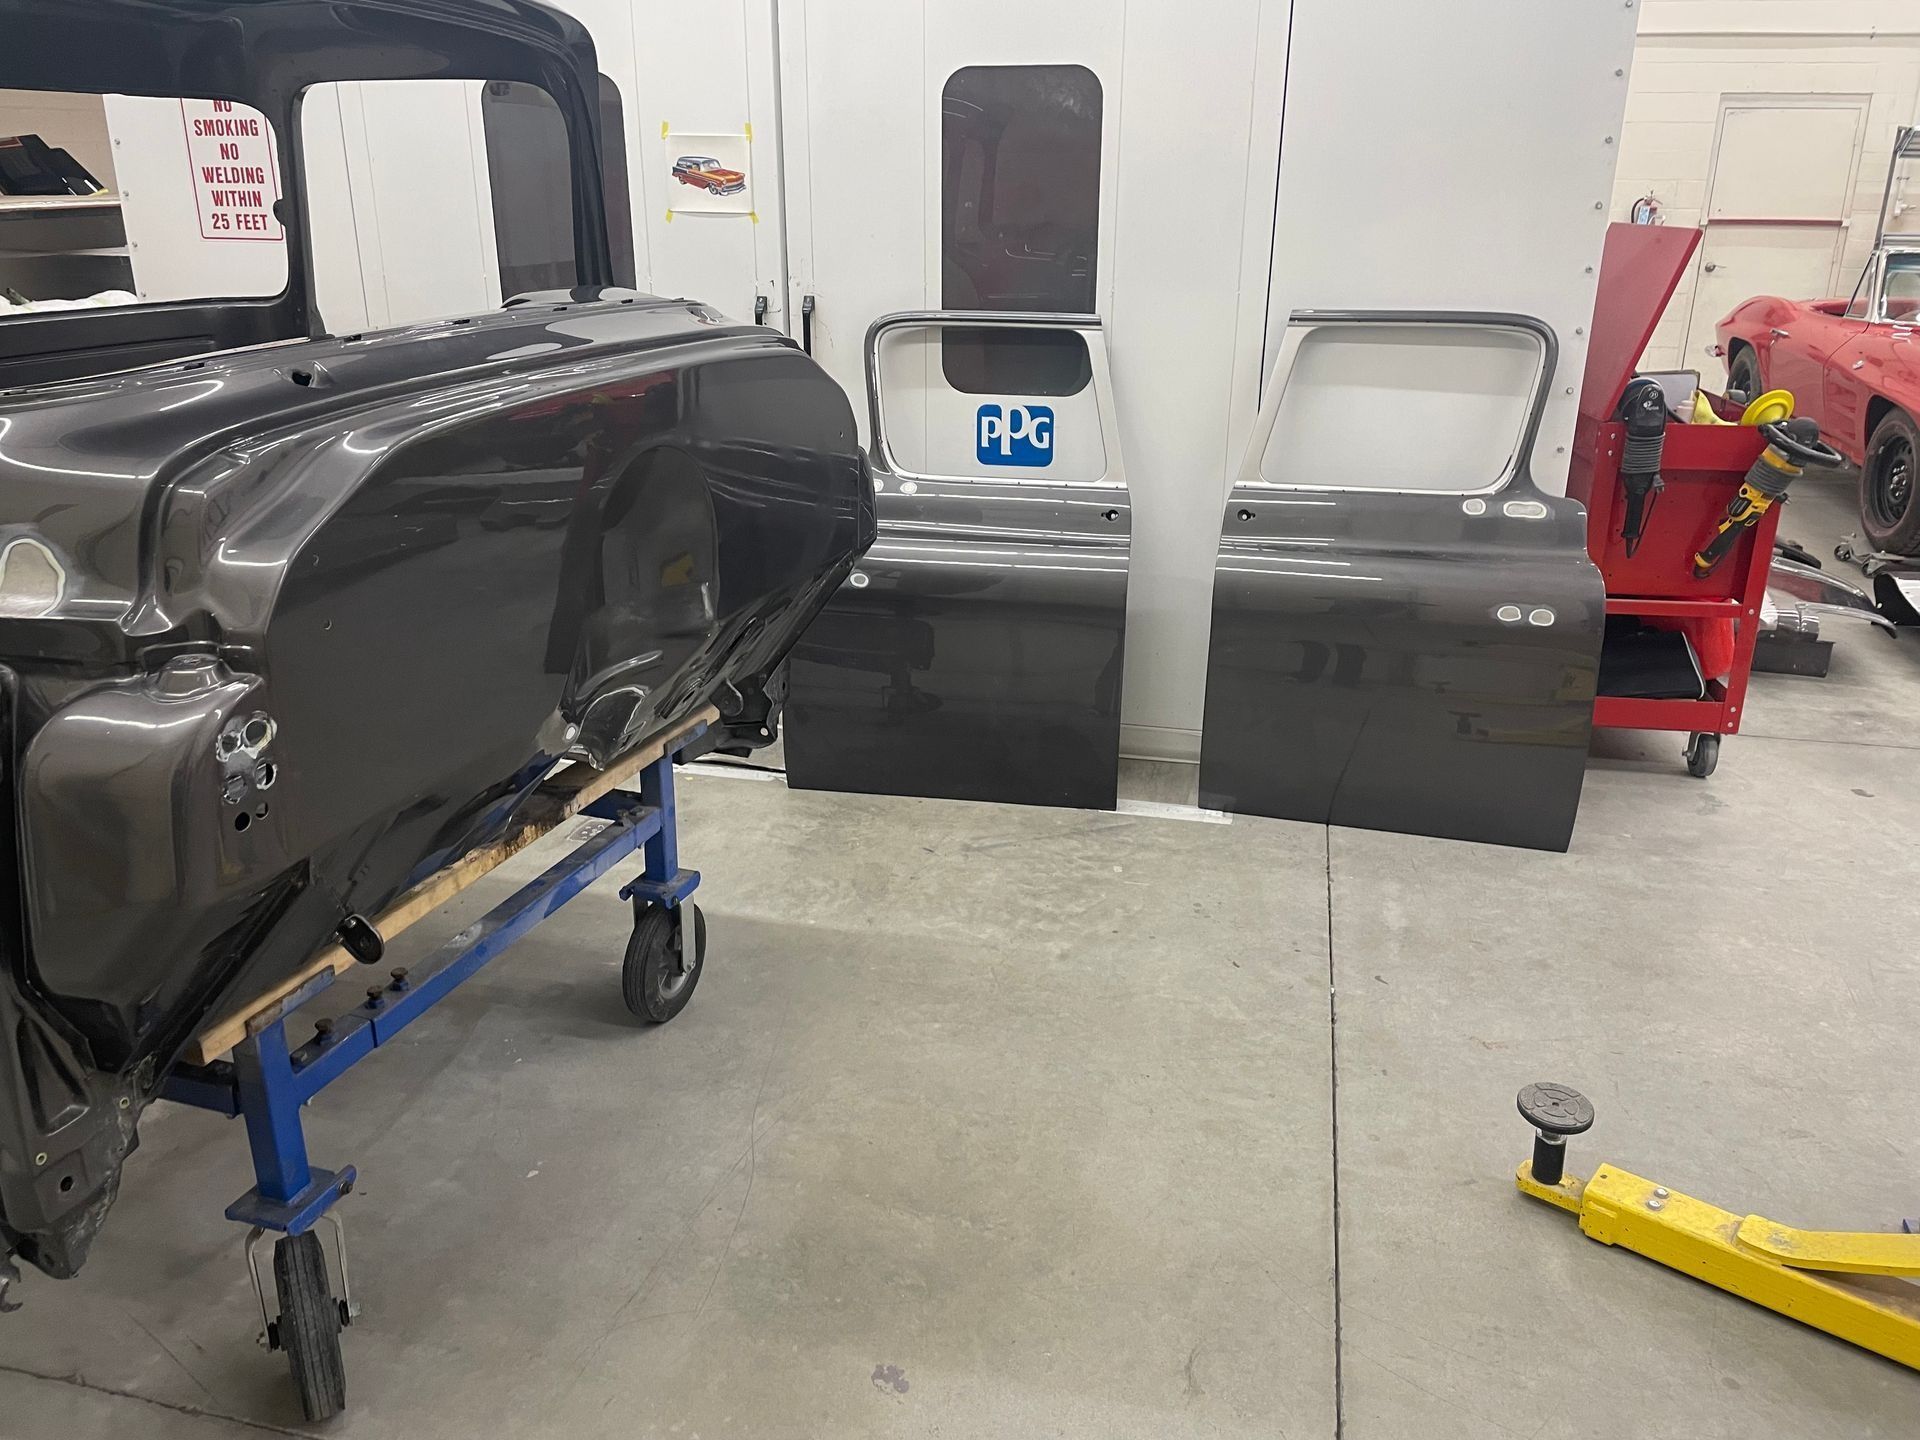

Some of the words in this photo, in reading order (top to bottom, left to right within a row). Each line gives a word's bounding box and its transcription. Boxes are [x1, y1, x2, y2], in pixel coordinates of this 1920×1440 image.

[194, 119, 259, 136] SMOKING
[219, 143, 240, 161] NO
[201, 166, 265, 184] WELDING
[211, 190, 263, 207] WITHIN
[211, 213, 230, 230] 25
[236, 214, 268, 231] FEET
[980, 403, 1050, 455] PPG
